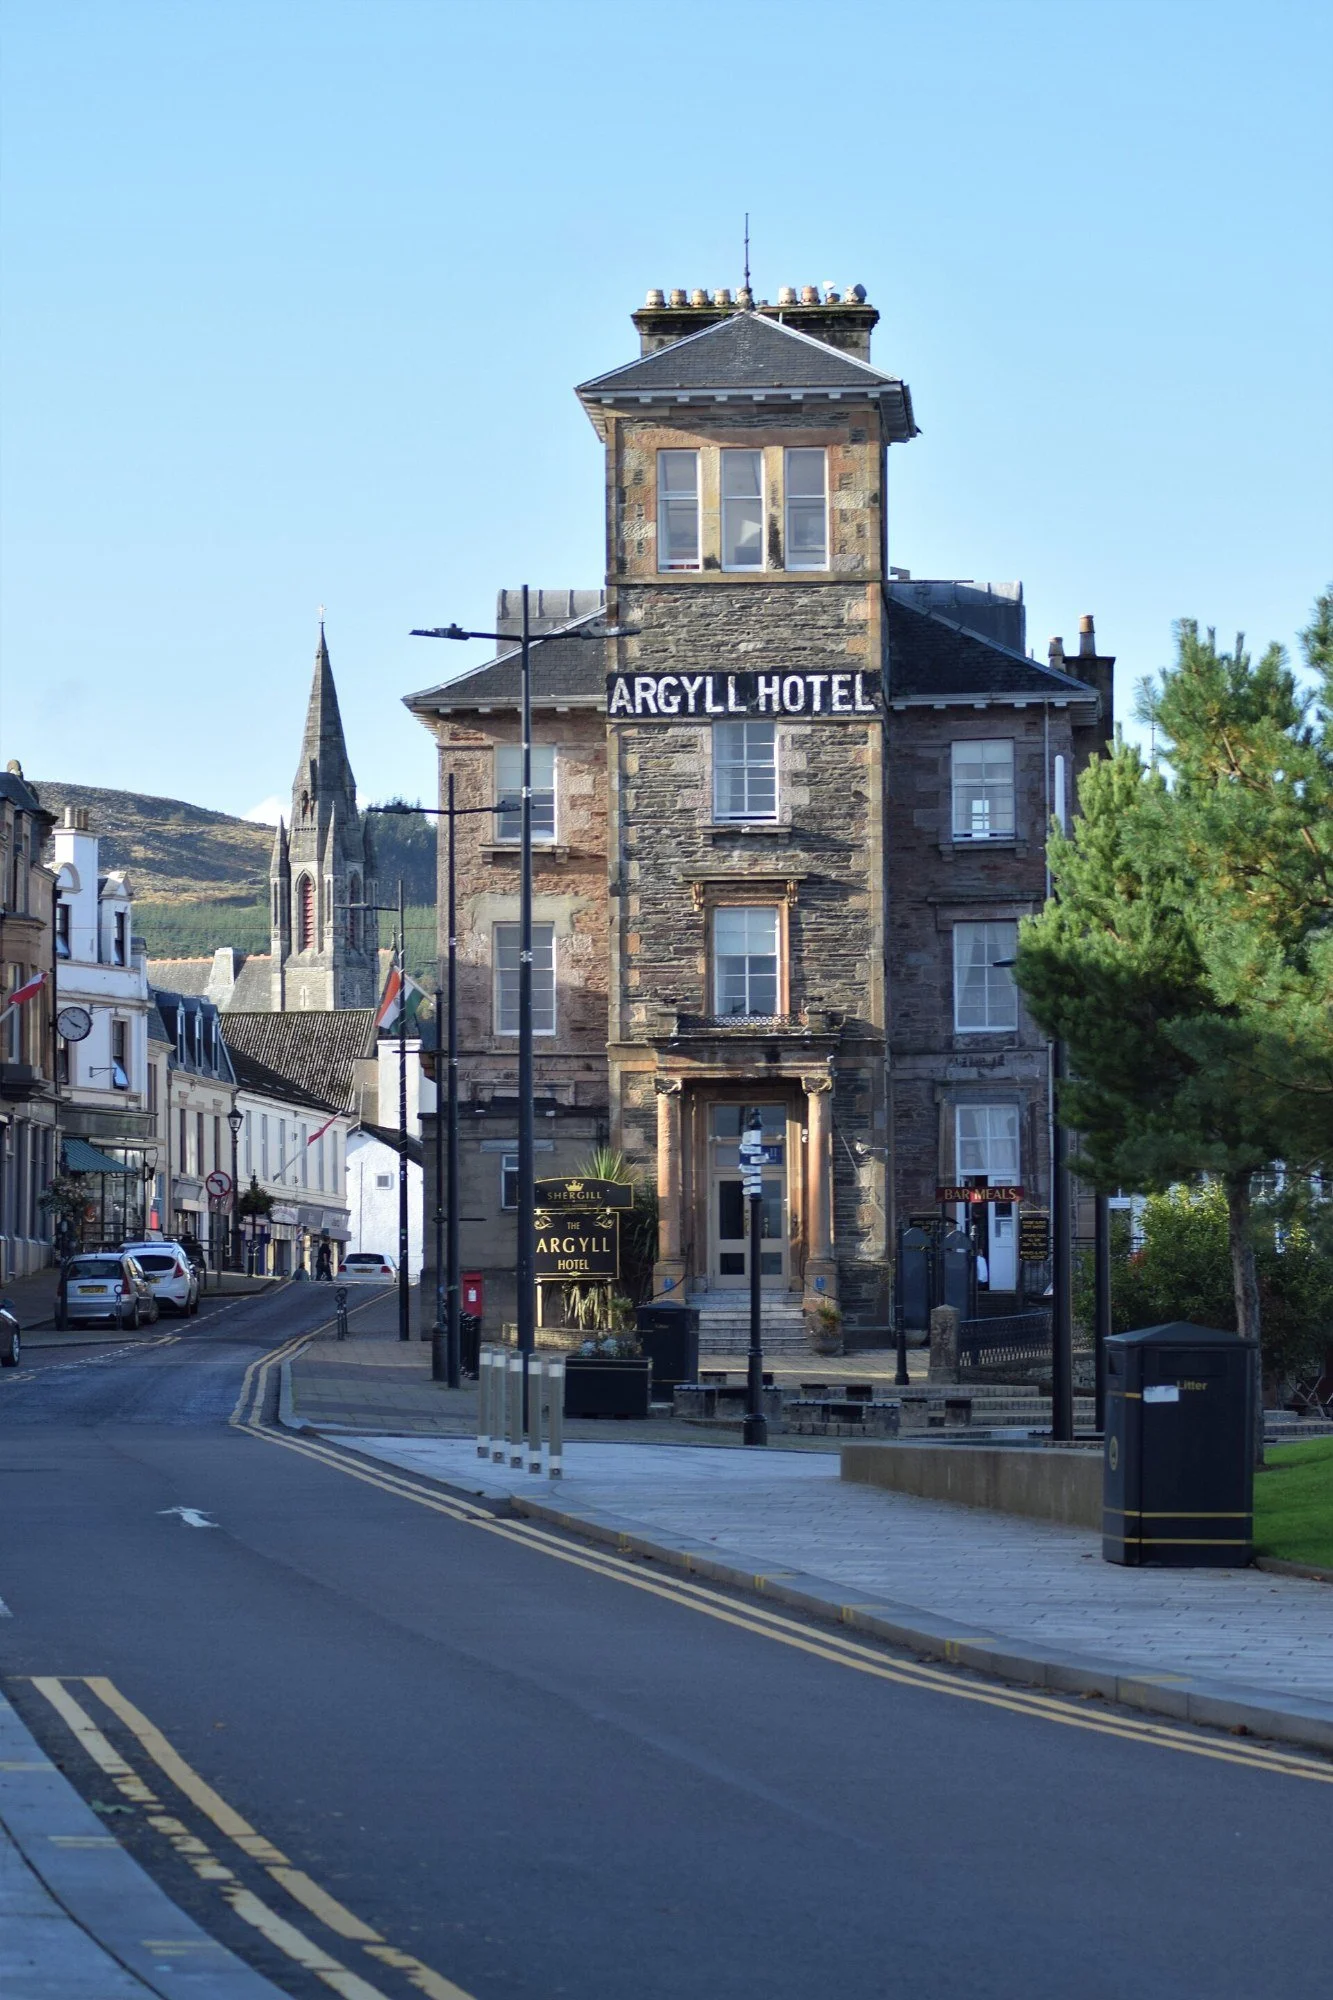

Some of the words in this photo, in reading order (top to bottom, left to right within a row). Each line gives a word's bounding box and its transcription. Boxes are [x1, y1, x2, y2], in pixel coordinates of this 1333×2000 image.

[609, 675, 747, 714] ARGYLL
[757, 674, 875, 712] HOTEL
[547, 1191, 602, 1200] SHERGILL
[944, 1188, 970, 1200] BAR
[974, 1188, 1017, 1200] MEALS
[567, 1221, 580, 1230] THE
[536, 1237, 611, 1253] ARGYLL
[557, 1259, 590, 1270] HOTEL
[1176, 1380, 1208, 1391] Litter
